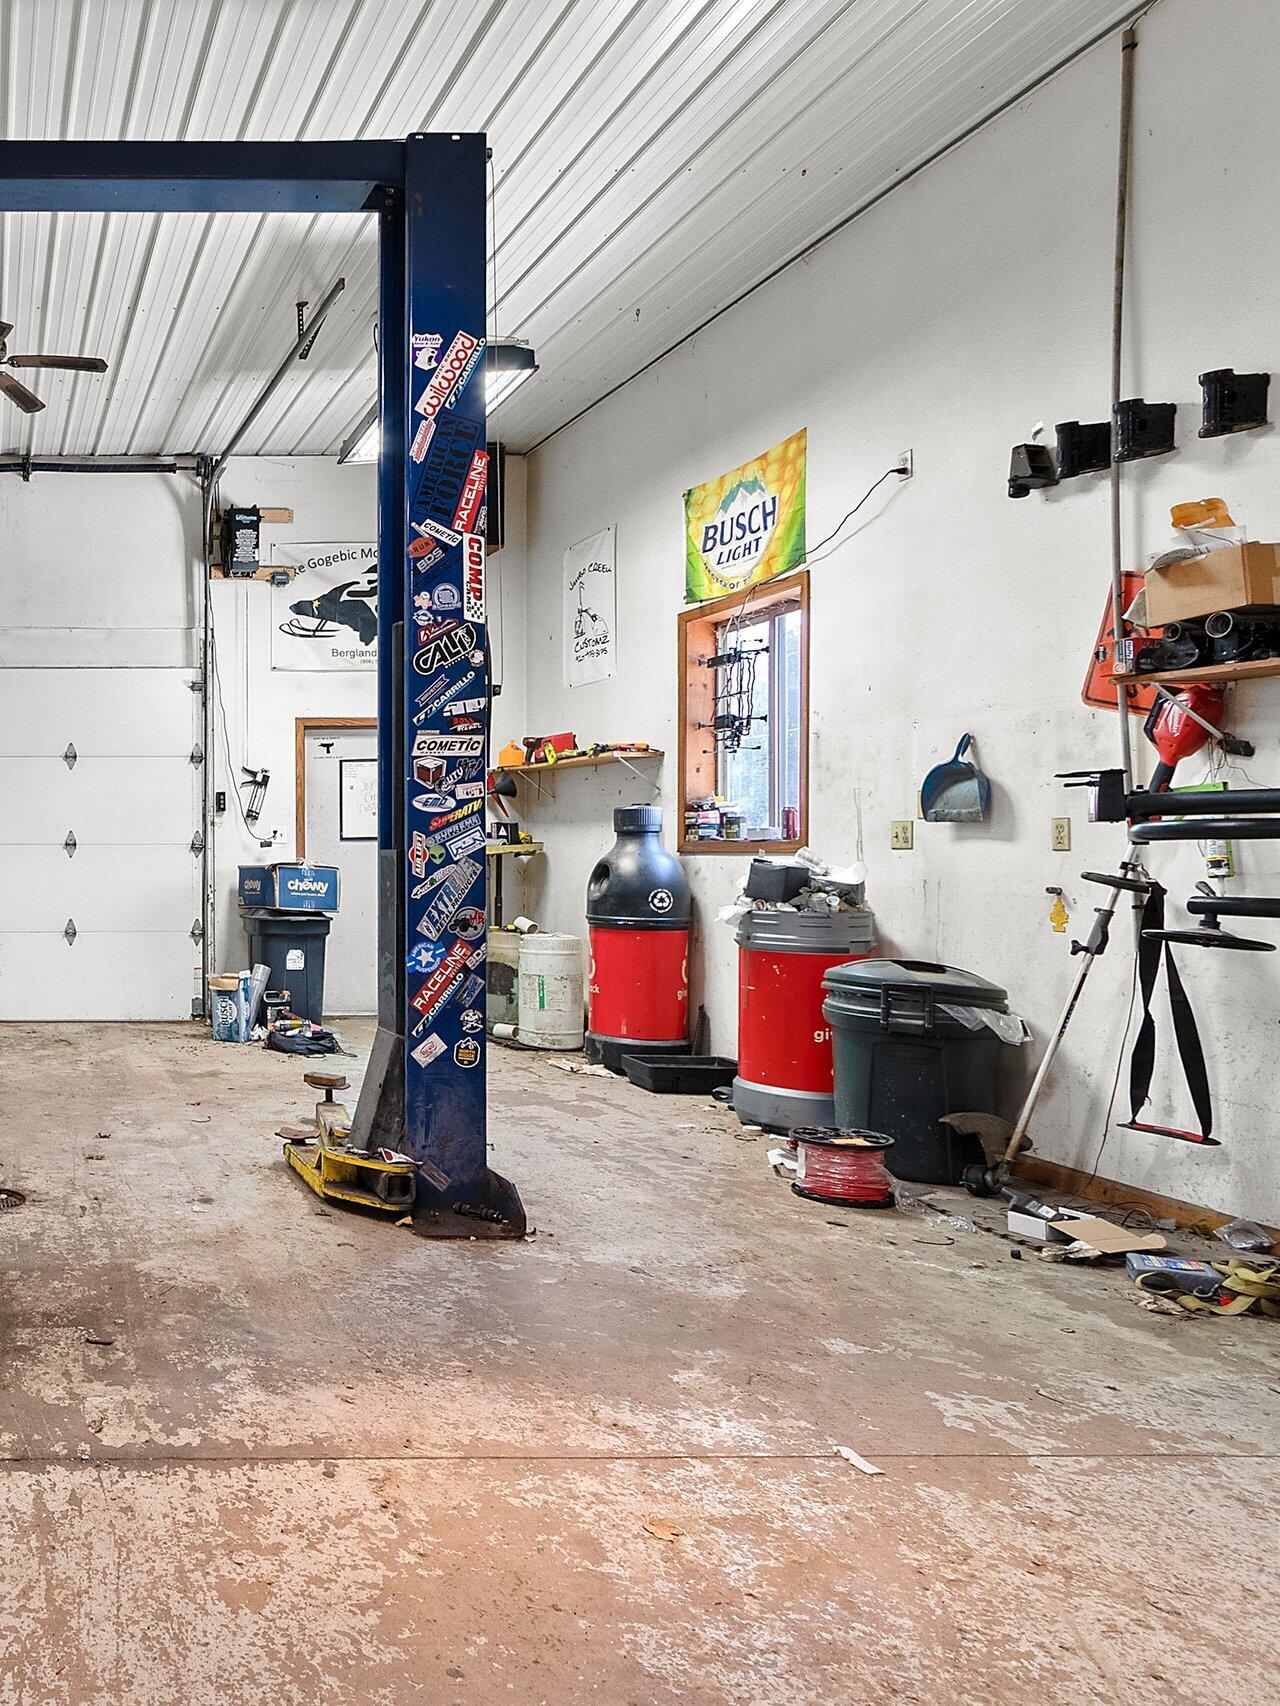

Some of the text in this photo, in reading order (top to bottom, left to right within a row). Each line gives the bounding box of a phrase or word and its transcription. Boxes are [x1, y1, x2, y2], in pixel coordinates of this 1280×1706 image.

[423, 332, 475, 417] wilwood
[459, 337, 486, 385] CARRILLO
[455, 455, 485, 531] RACELINE
[423, 522, 459, 544] COMETIC
[702, 495, 777, 554] BUSCH
[307, 549, 358, 569] Gogebic
[360, 548, 378, 559] Mo
[416, 547, 443, 571] BDS
[716, 536, 762, 566] LIGHT
[468, 537, 483, 601] COMP
[331, 648, 377, 659] Bergland
[434, 671, 475, 707] CARRILLO
[416, 738, 481, 751] COMETIC
[244, 878, 261, 891] chewy
[287, 878, 329, 893] chewy
[434, 908, 453, 934] METAL
[450, 869, 479, 909] PRODUCTS
[413, 943, 466, 1010] RACELINE
[429, 972, 464, 1016] CARRILLO
[220, 995, 229, 1026] BUSCH
[814, 1028, 833, 1043] gi
